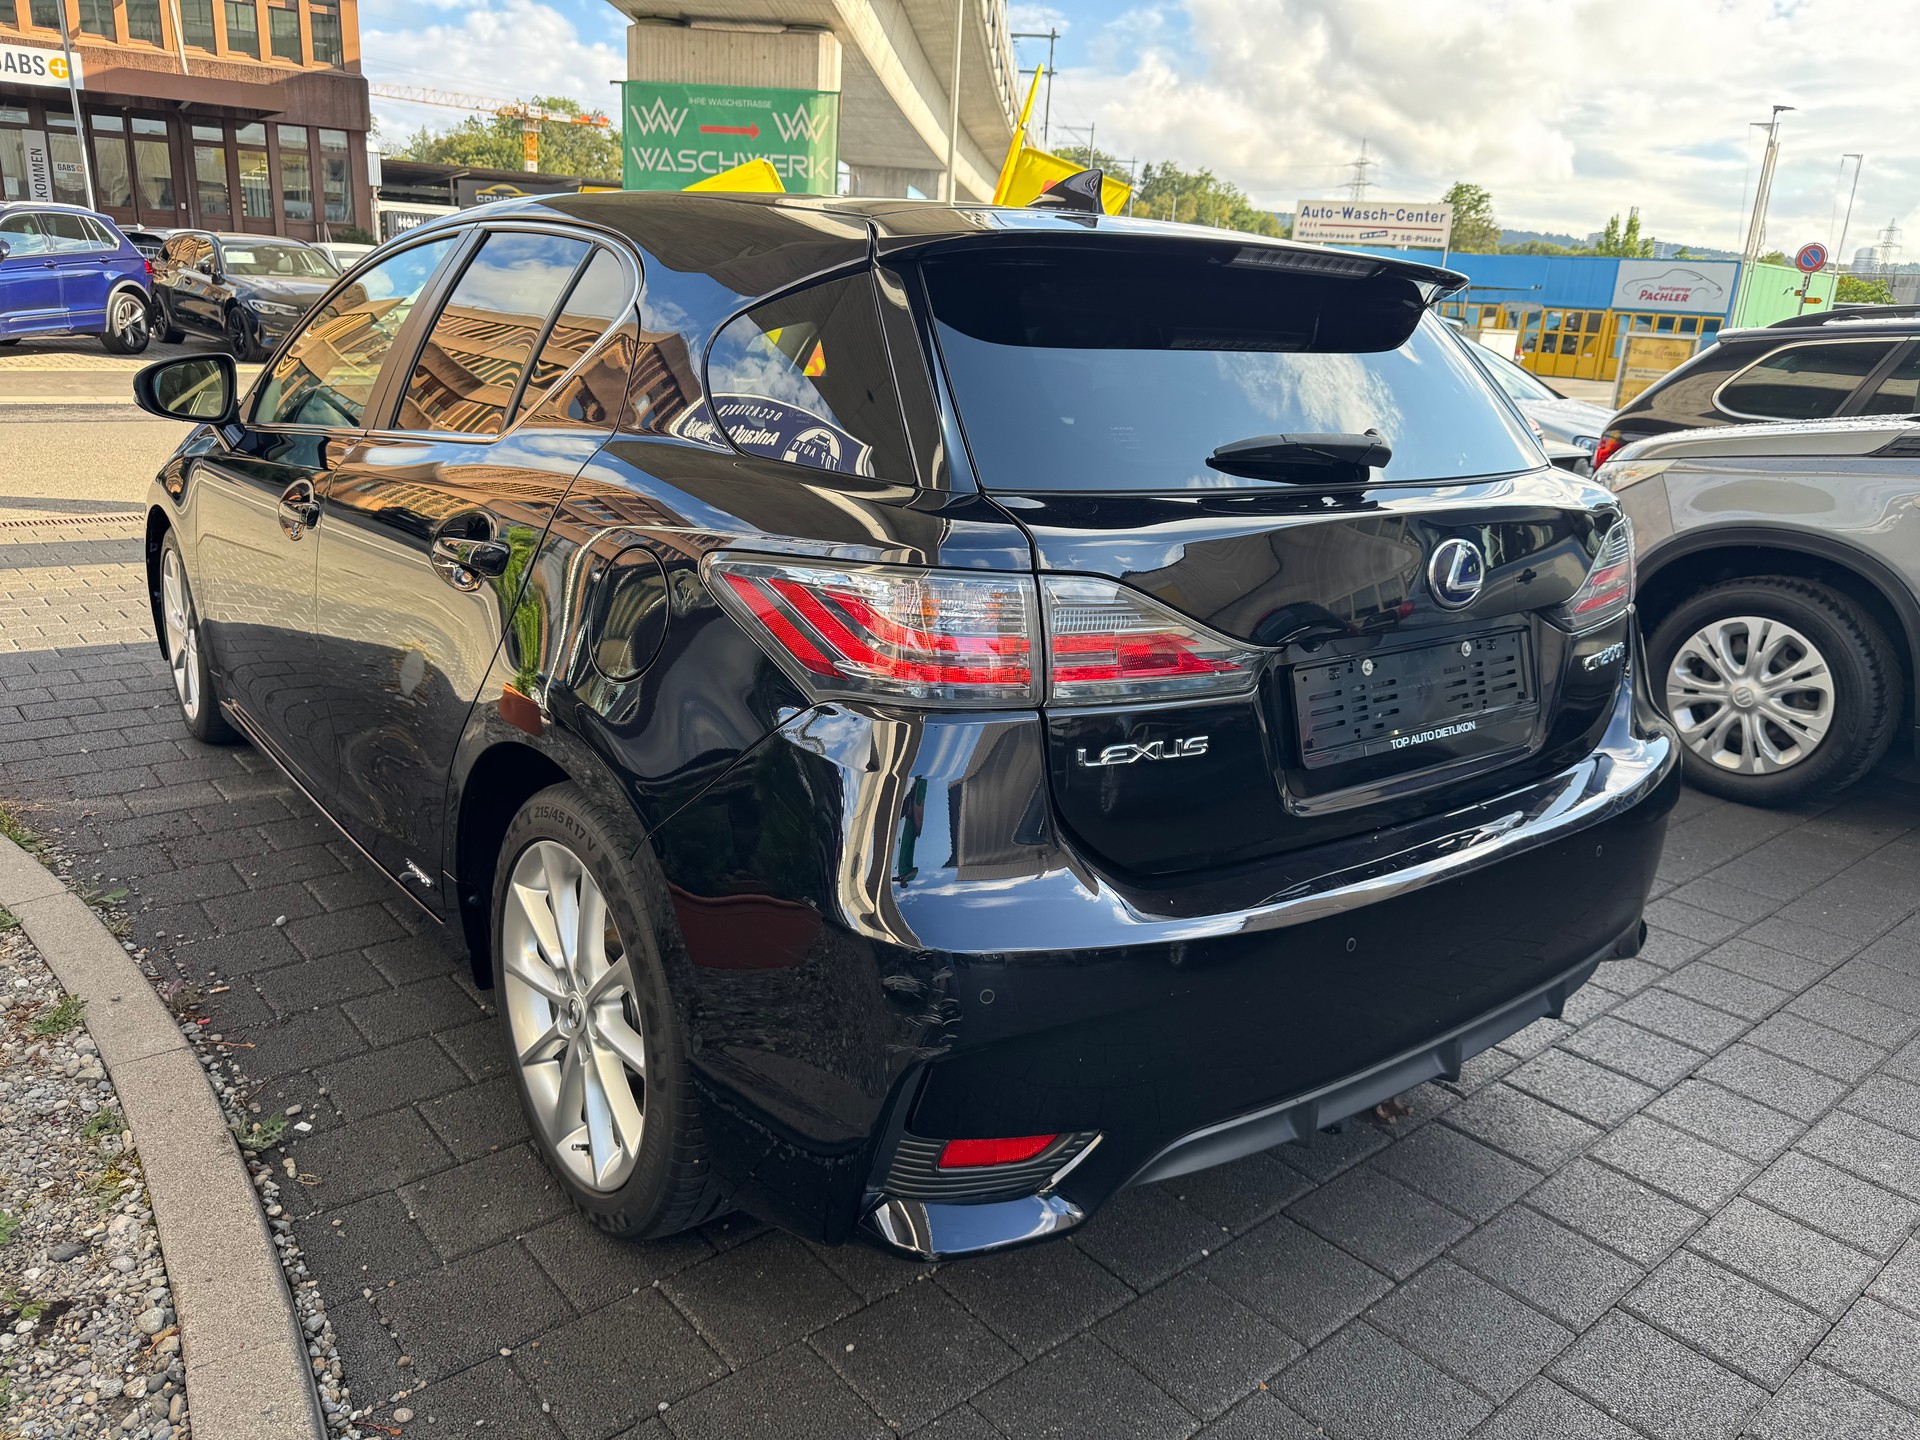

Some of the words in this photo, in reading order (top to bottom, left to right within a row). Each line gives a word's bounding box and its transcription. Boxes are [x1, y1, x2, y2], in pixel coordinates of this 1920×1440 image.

[0, 51, 46, 77] ABS
[688, 97, 706, 106] IHRE
[708, 98, 772, 109] WASCHSTRASSE
[30, 148, 48, 202] KOMMEN
[57, 163, 76, 172] GABS
[1301, 205, 1446, 223] Auto-Wasch-Center
[1298, 230, 1355, 240] Waschstrasse
[1638, 290, 1690, 303] PACHLER
[1390, 736, 1410, 750] TOP
[1411, 730, 1435, 746] AUTO
[1435, 720, 1477, 739] DIETLIKON
[1077, 735, 1209, 767] LEXUS
[534, 806, 566, 824] 215/45
[565, 815, 574, 831] R
[574, 823, 587, 840] 17
[586, 836, 597, 852] V
